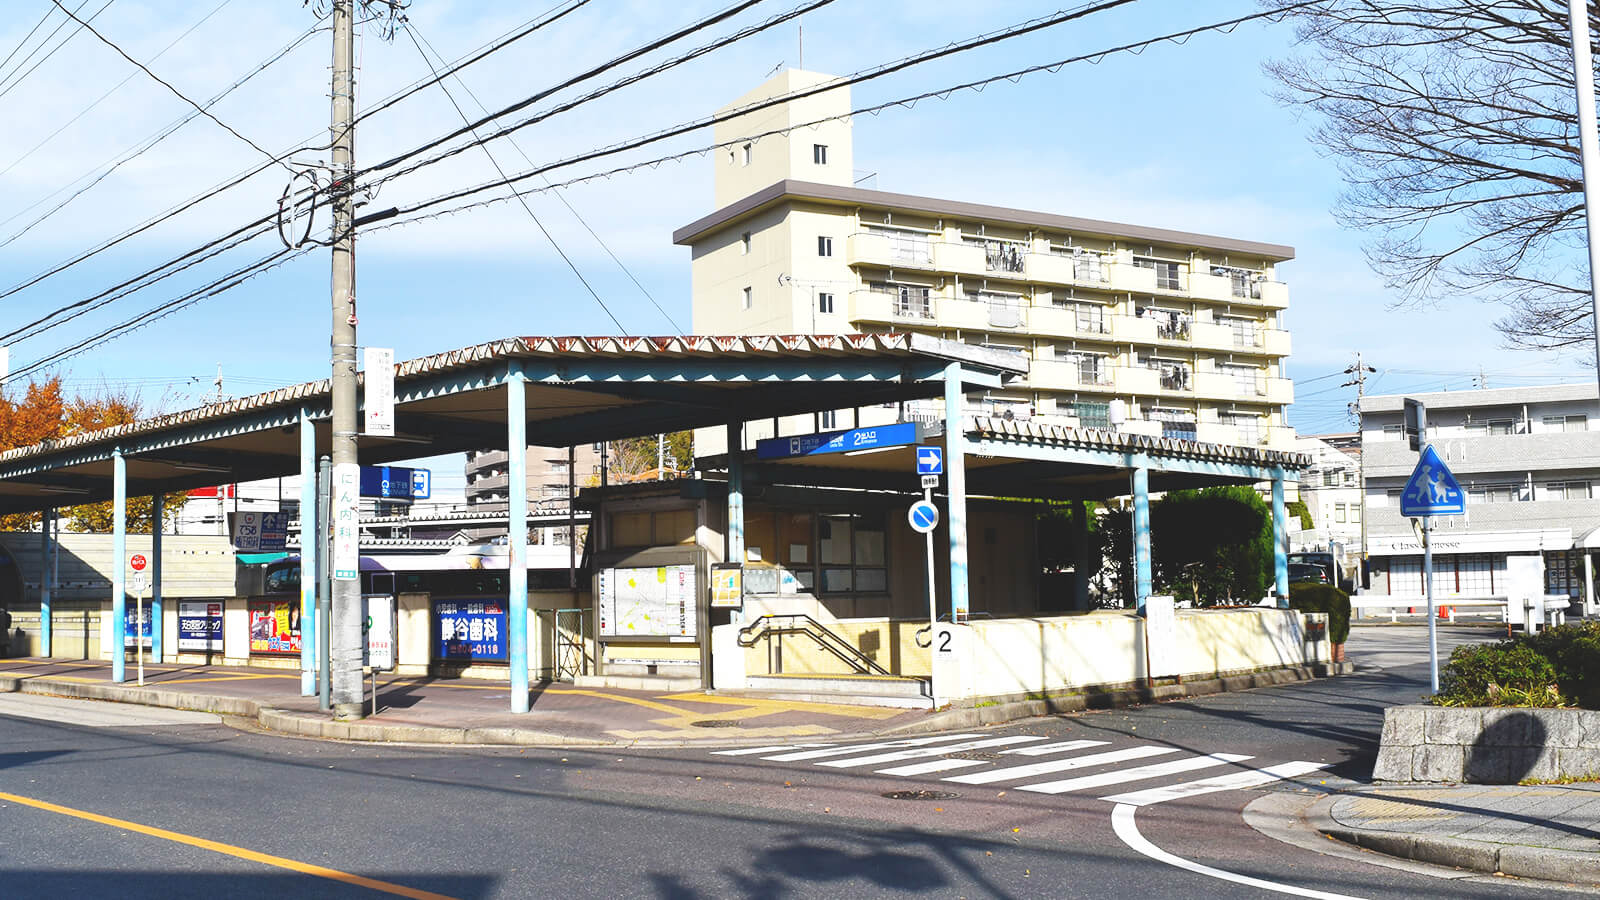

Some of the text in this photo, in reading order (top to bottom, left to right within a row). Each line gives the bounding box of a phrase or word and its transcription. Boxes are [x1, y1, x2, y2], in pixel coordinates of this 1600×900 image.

[340, 473, 353, 537] にん内科
[441, 617, 499, 642] 藤谷歯科
[938, 630, 952, 652] 2
